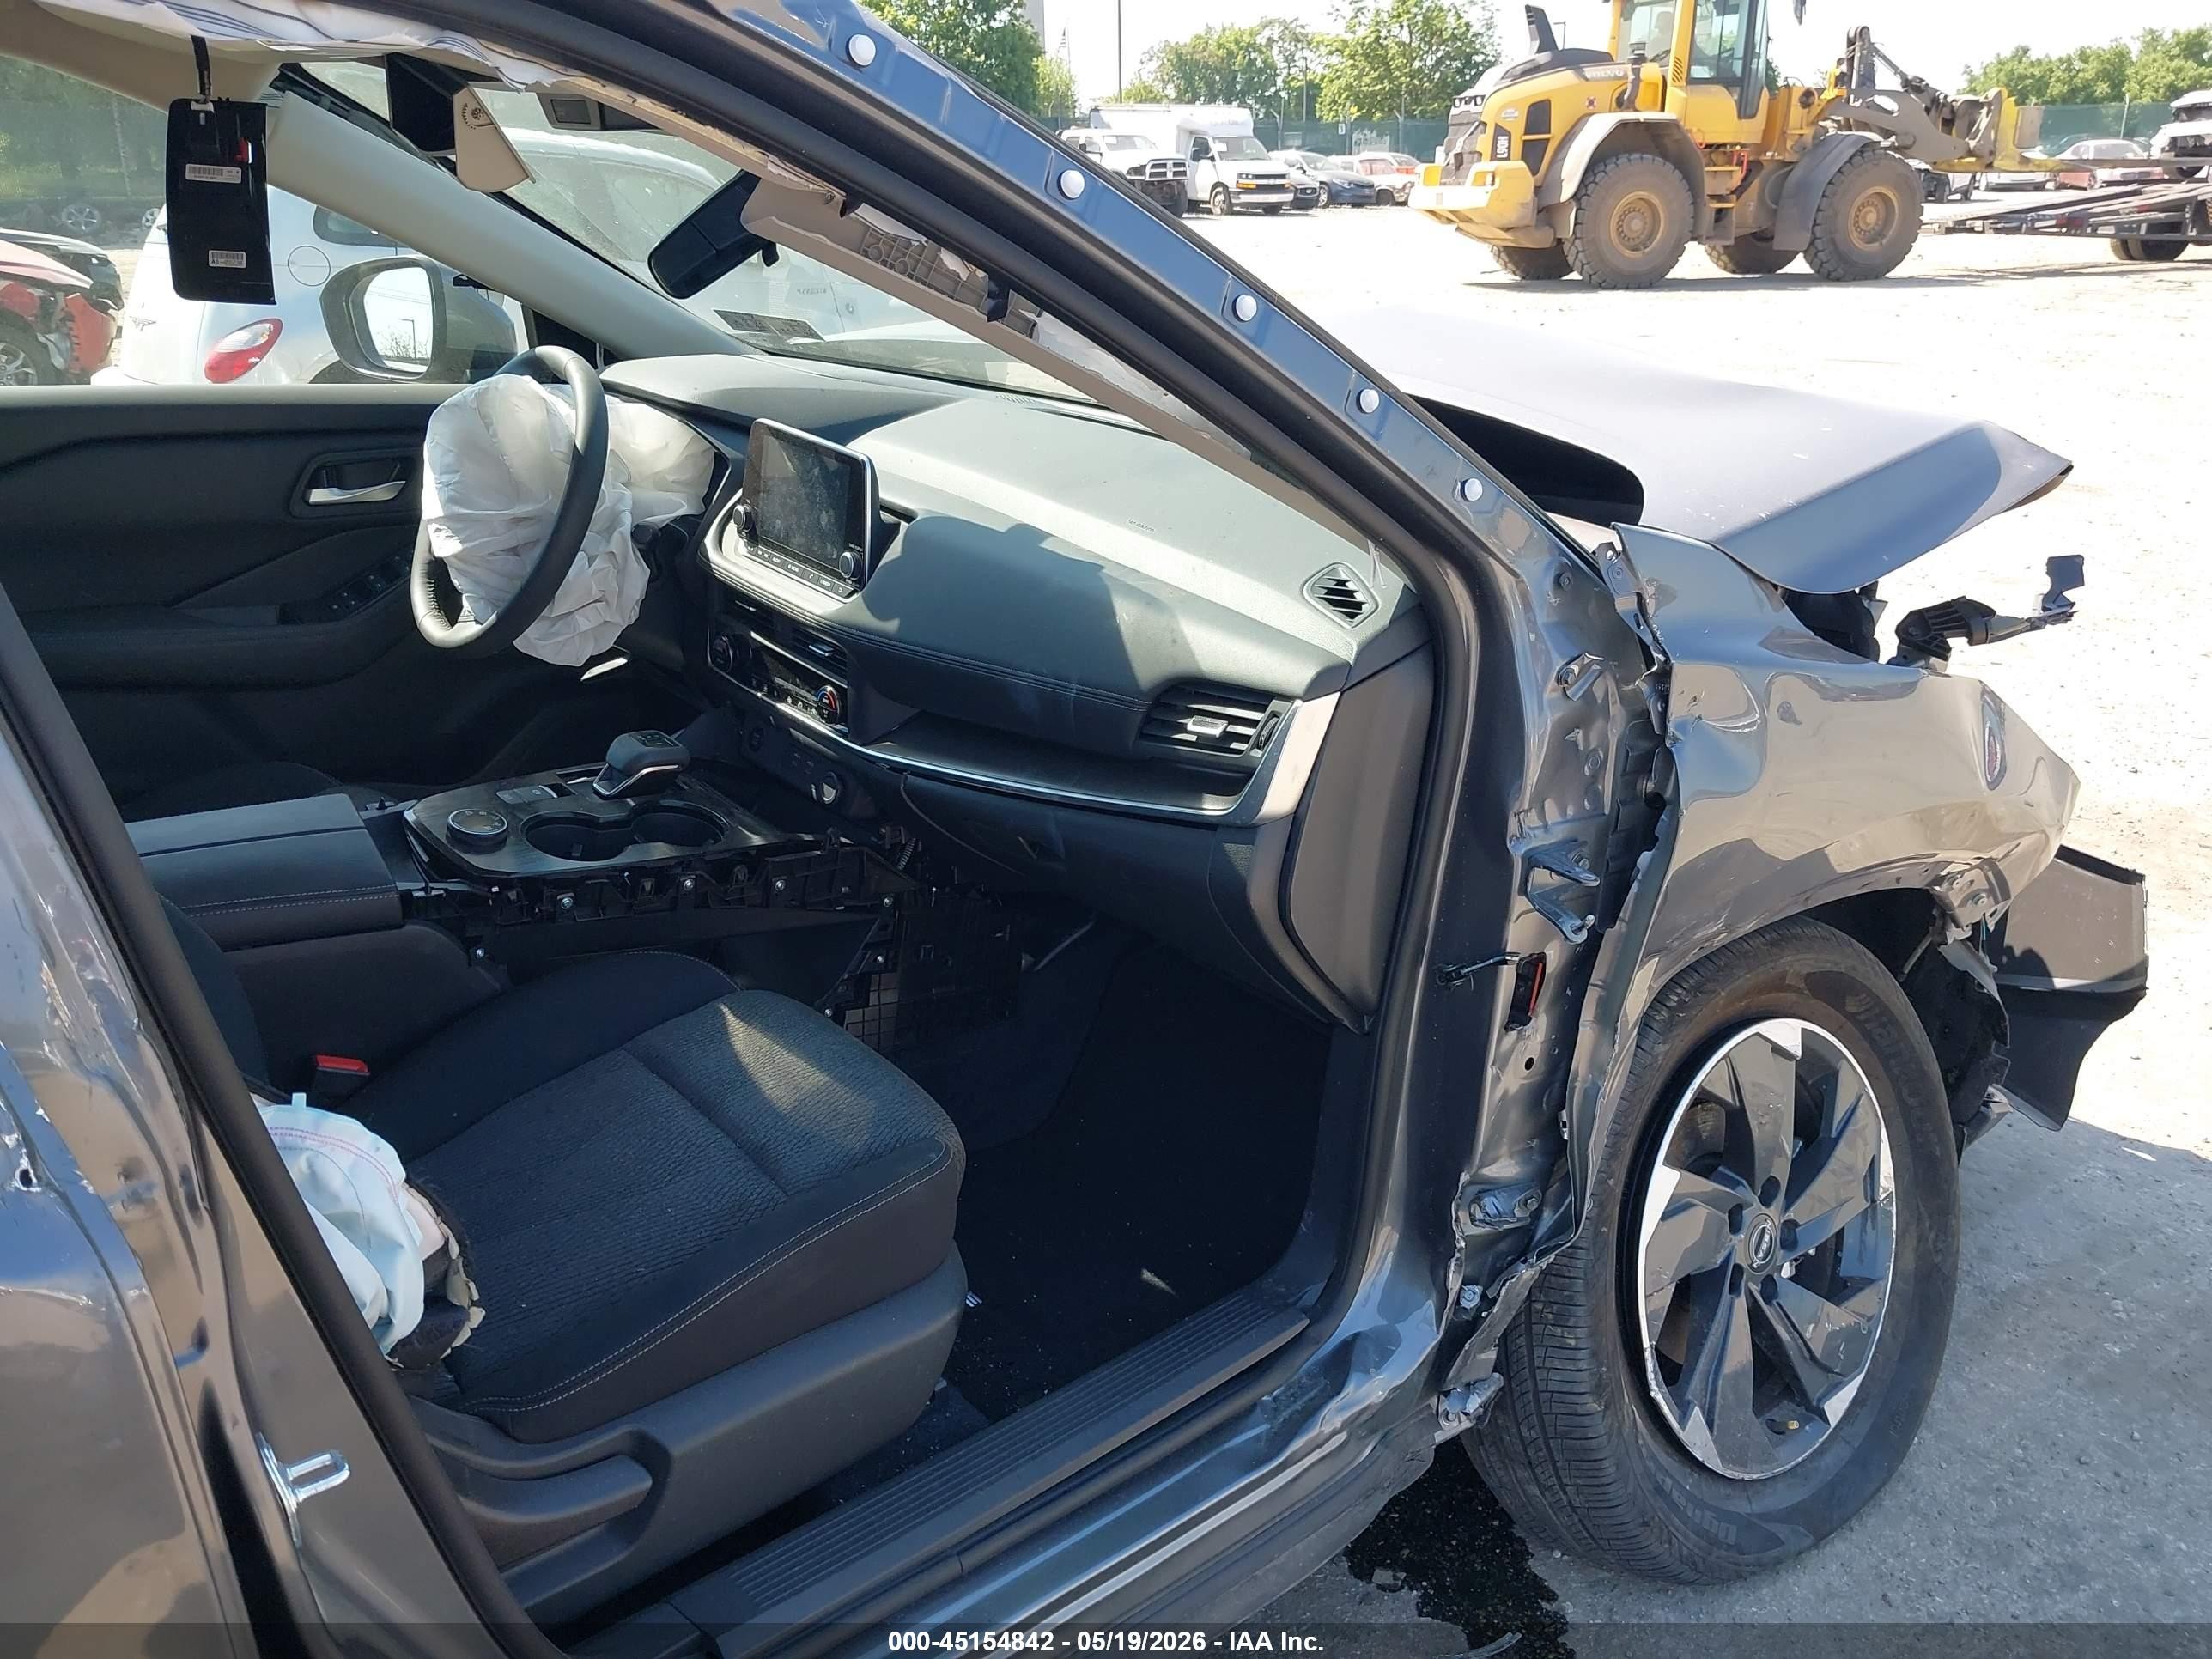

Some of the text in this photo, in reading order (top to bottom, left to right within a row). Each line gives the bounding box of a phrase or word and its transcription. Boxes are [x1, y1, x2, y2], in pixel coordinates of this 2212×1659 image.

[1584, 70, 1624, 78] VOLVO
[1497, 136, 1509, 158] L90H
[1751, 1218, 1772, 1268] NISSAN
